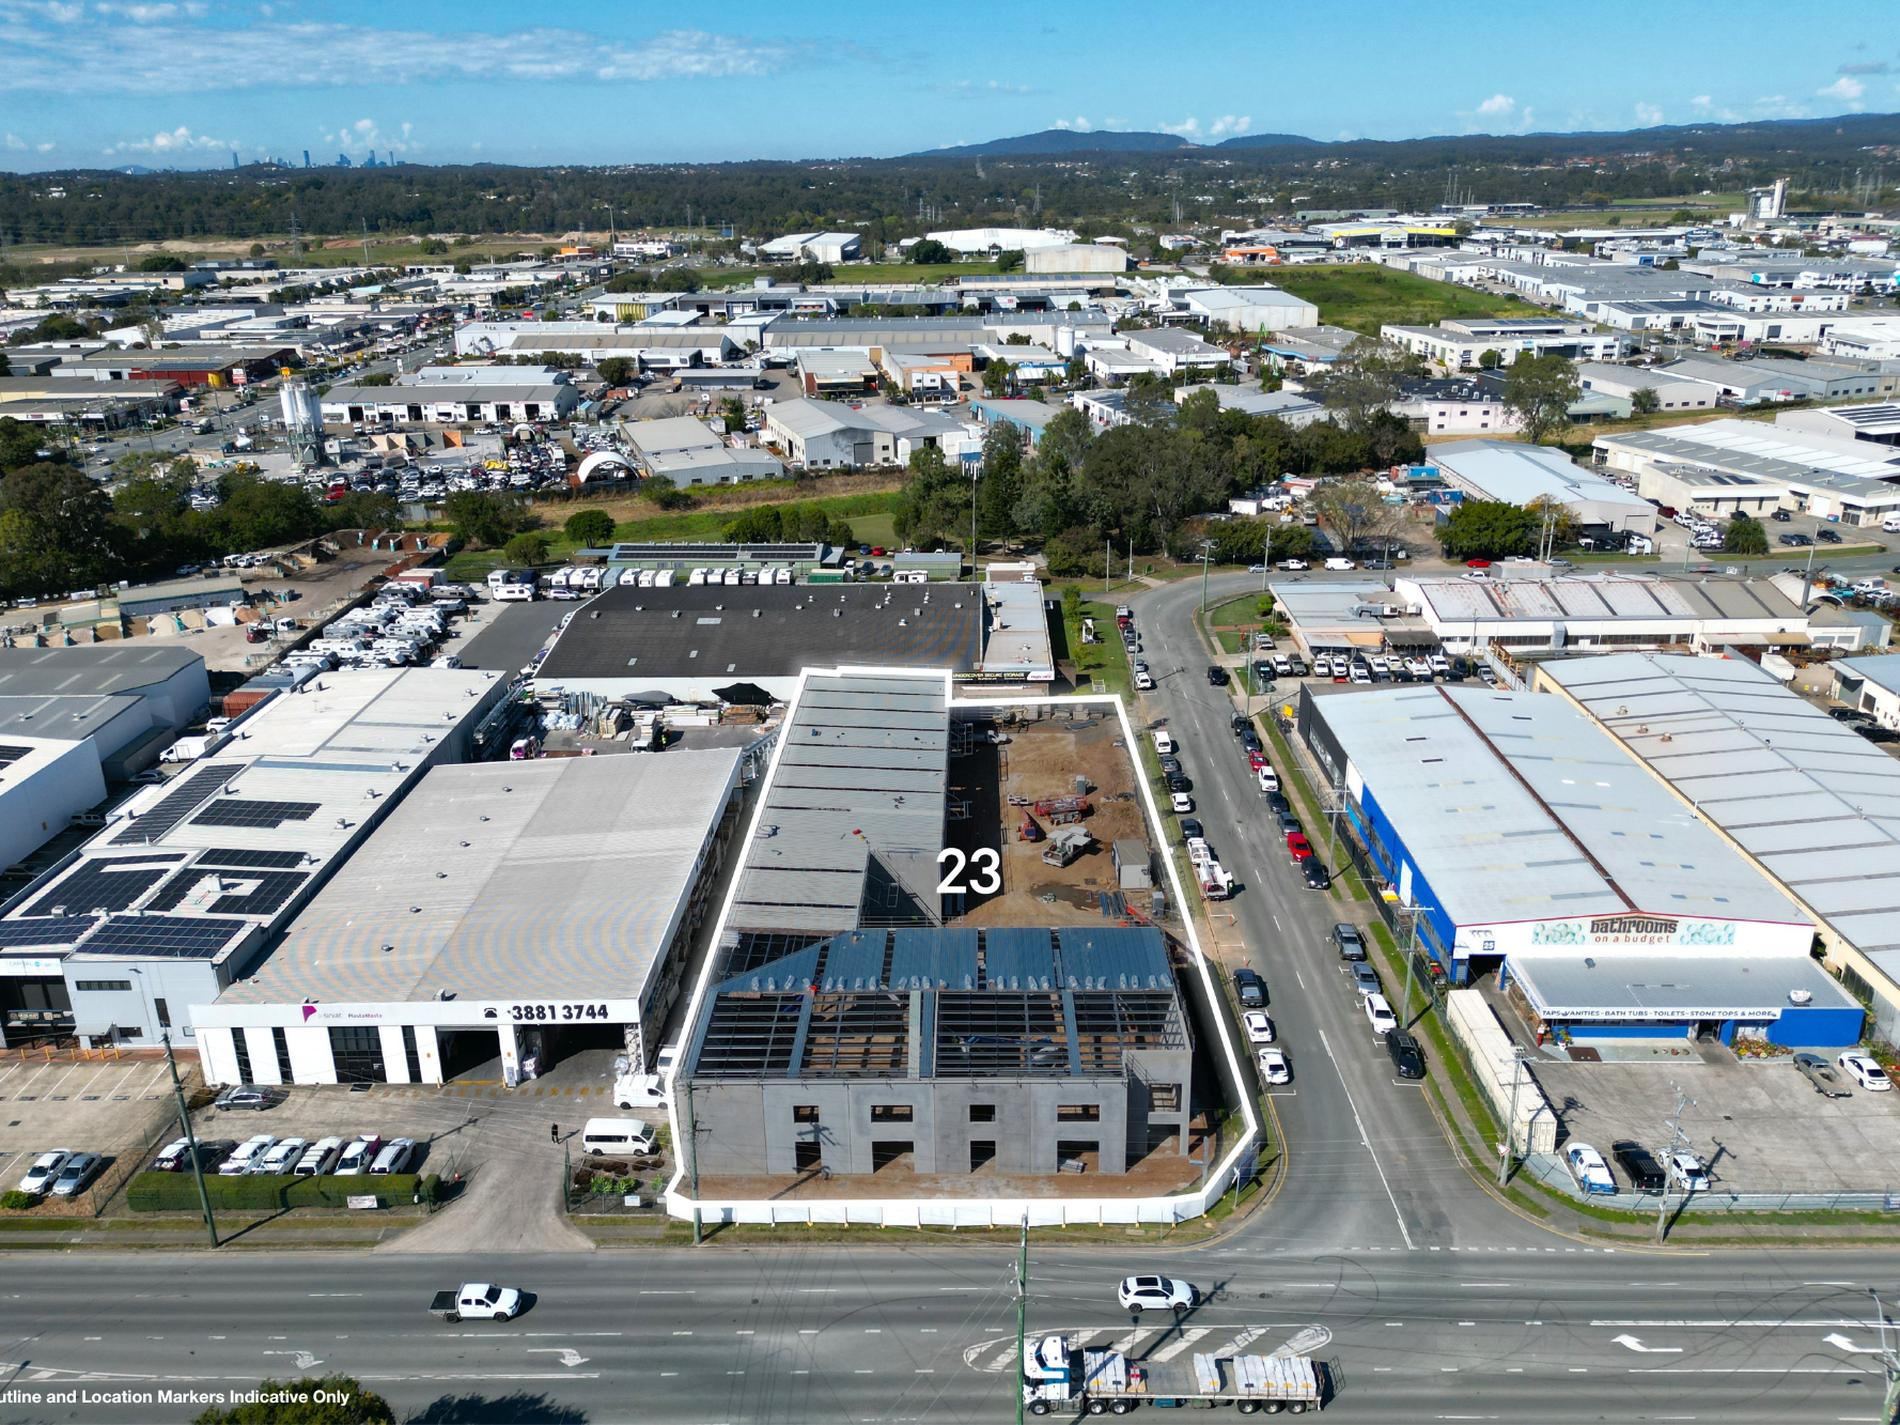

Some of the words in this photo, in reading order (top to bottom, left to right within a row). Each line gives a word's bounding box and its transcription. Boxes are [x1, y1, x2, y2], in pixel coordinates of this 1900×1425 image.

[1590, 917, 1678, 933] bathrooms
[1595, 935, 1608, 943] on
[1624, 934, 1670, 945] budget
[512, 1004, 556, 1020] 3881
[562, 1004, 609, 1020] 3744
